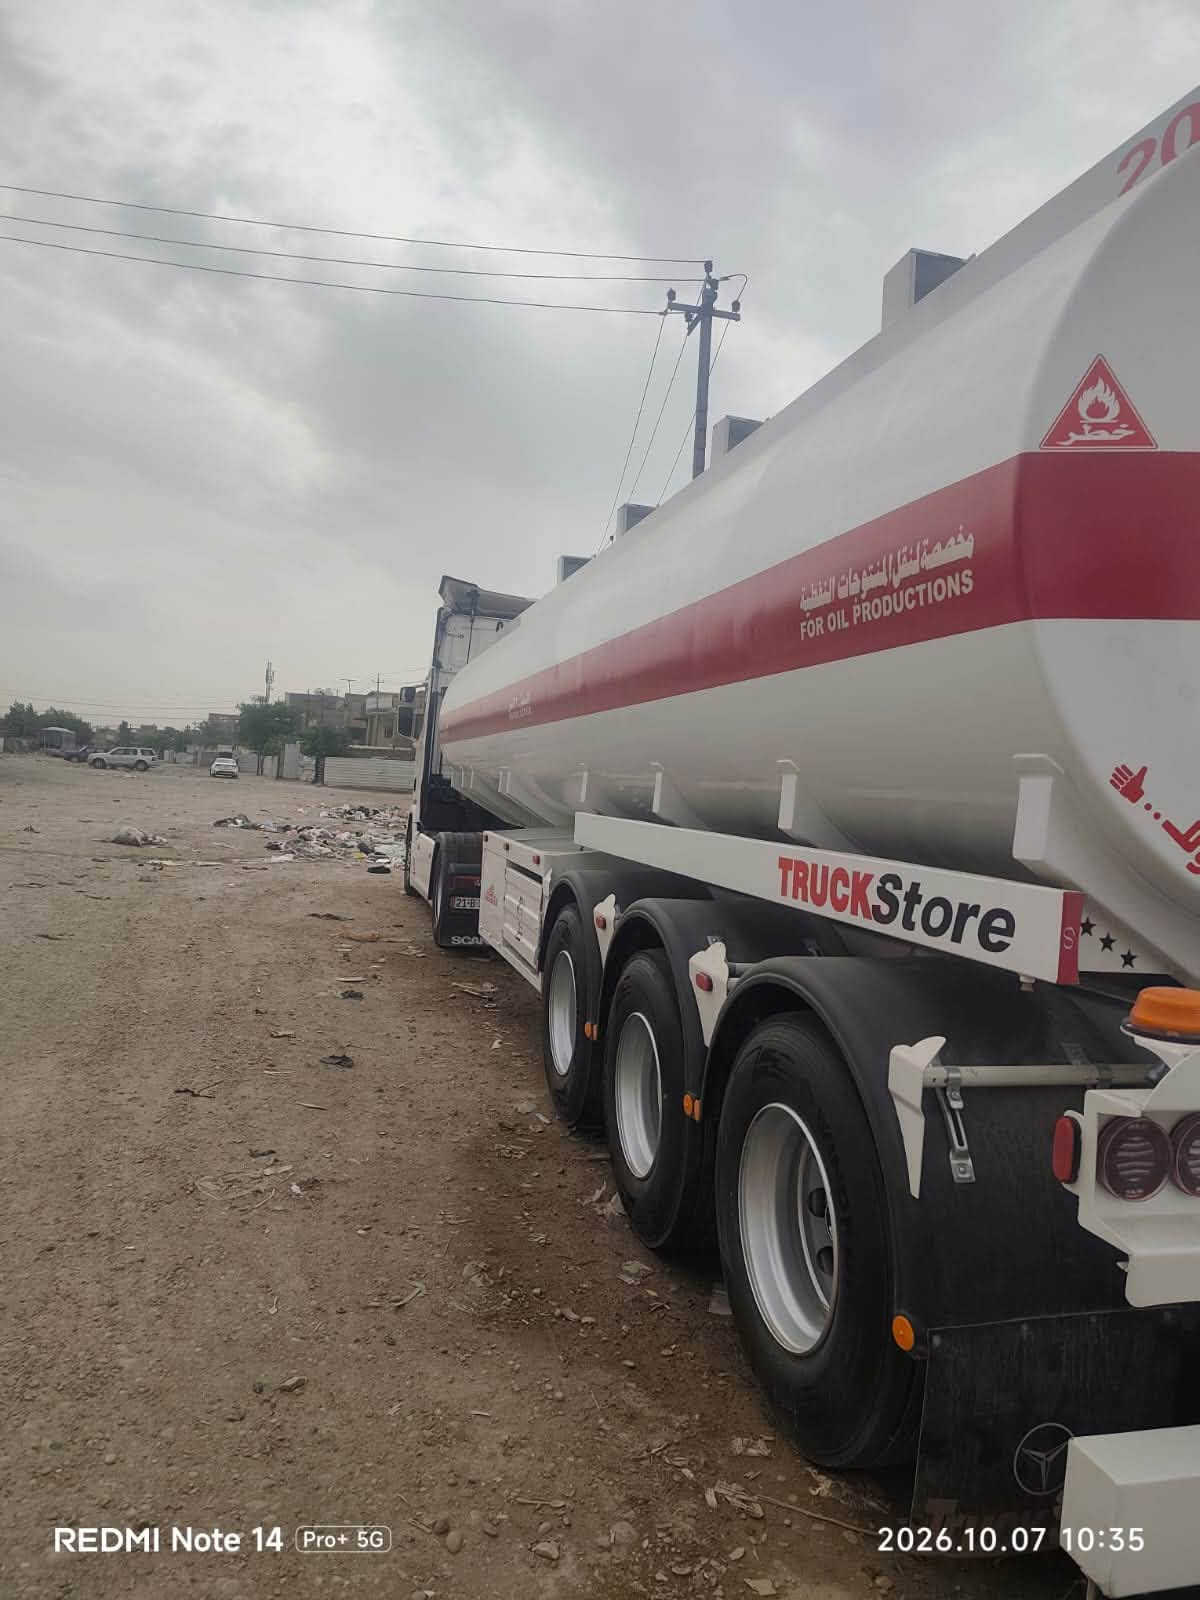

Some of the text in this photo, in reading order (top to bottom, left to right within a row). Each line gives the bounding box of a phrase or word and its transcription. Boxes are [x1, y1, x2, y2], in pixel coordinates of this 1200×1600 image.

[1056, 424, 1136, 446] خطر
[893, 541, 921, 589] لنقل
[921, 524, 975, 571] مخصصة
[800, 569, 974, 641] FOR OIL PRODUCTIONS
[778, 856, 1016, 953] TRUCKStore
